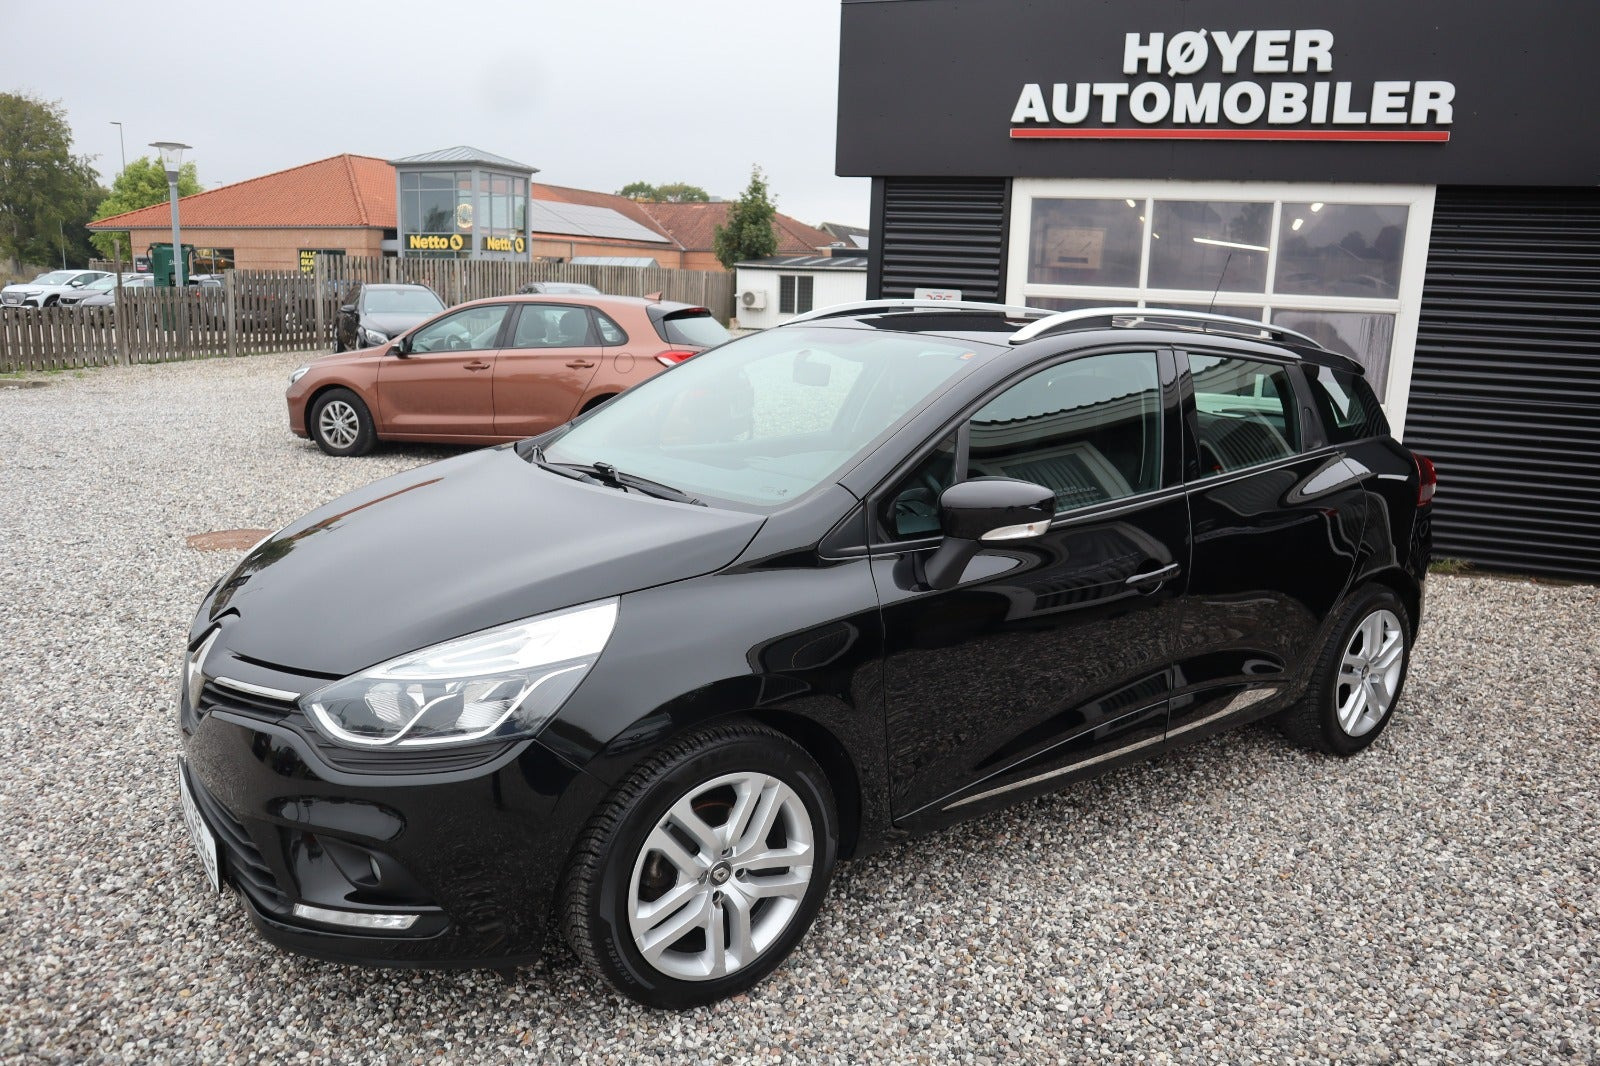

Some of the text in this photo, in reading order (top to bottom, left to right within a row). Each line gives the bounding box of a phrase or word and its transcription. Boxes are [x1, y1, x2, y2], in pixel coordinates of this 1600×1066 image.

[1123, 28, 1334, 77] HØYER
[1010, 81, 1456, 124] AUTOMOBILER
[409, 235, 449, 250] Netto
